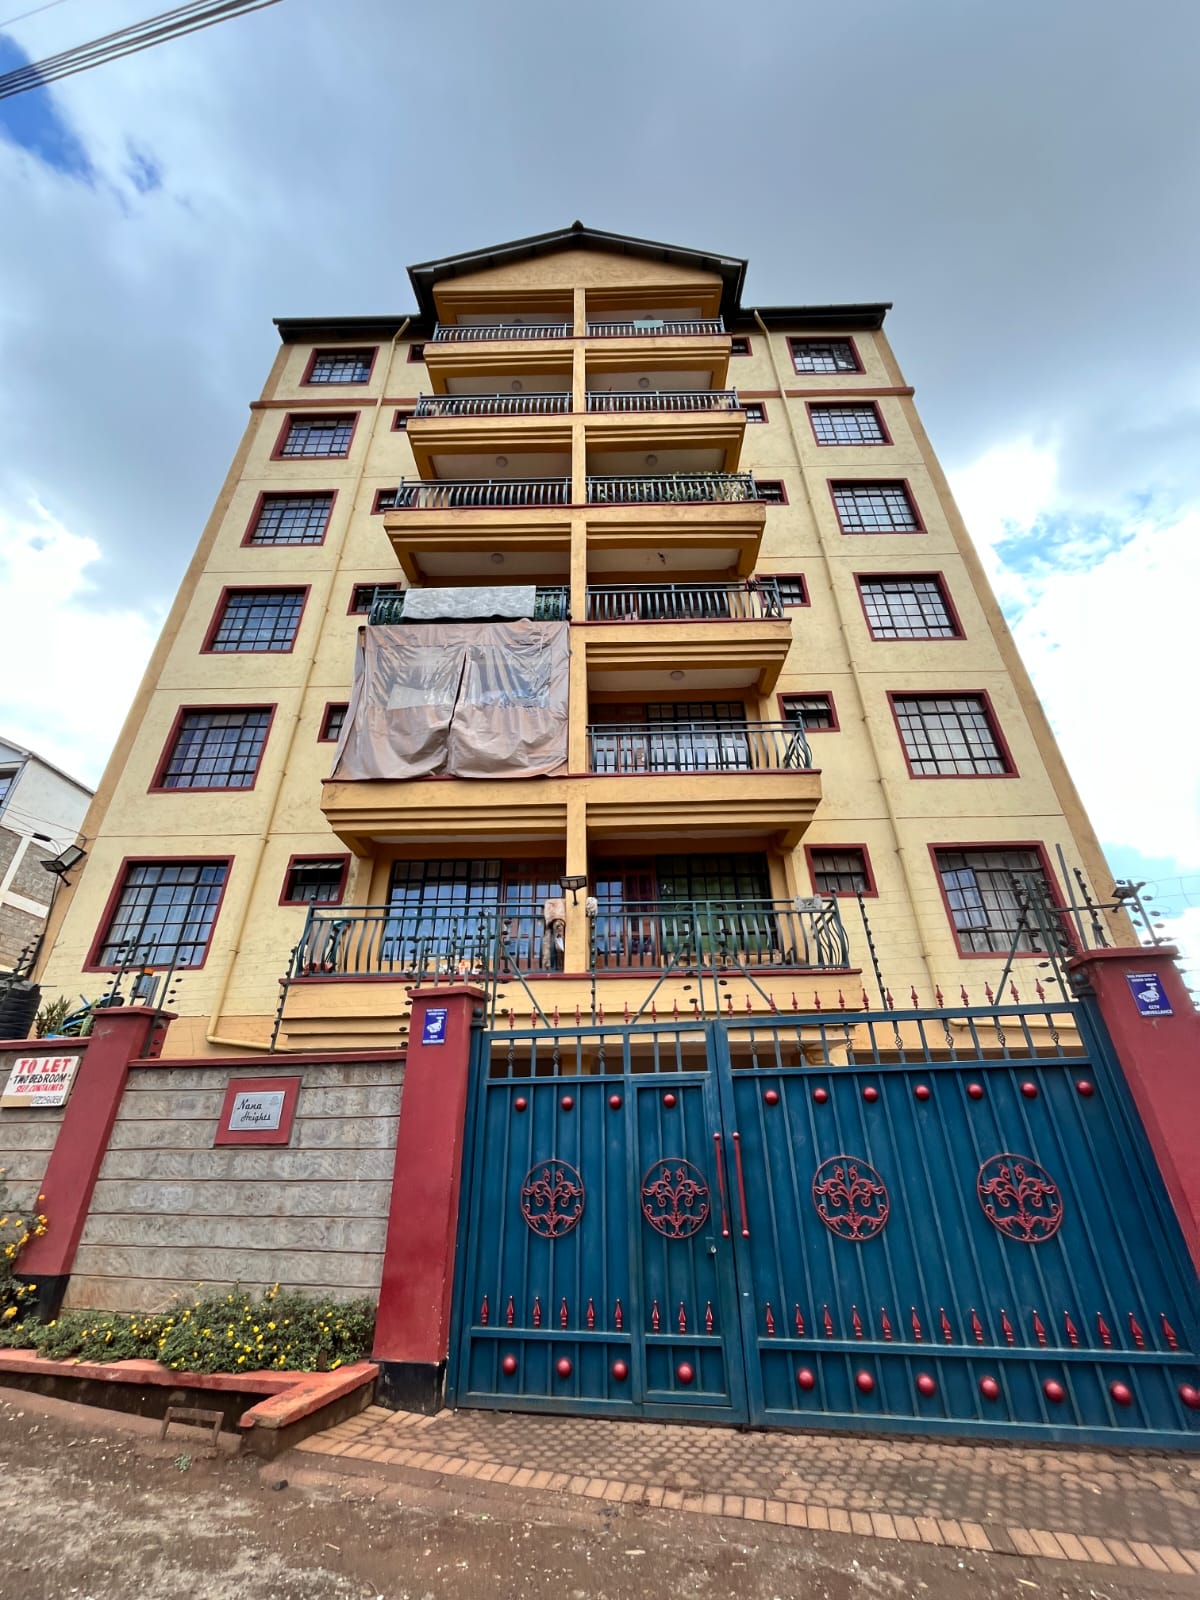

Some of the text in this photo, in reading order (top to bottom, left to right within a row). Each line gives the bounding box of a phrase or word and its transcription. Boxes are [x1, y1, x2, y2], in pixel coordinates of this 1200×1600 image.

[18, 1058, 72, 1074] TO LET
[13, 1073, 67, 1084] TWO BEDROOM
[237, 1098, 263, 1110] Nana
[240, 1110, 271, 1124] Heights
